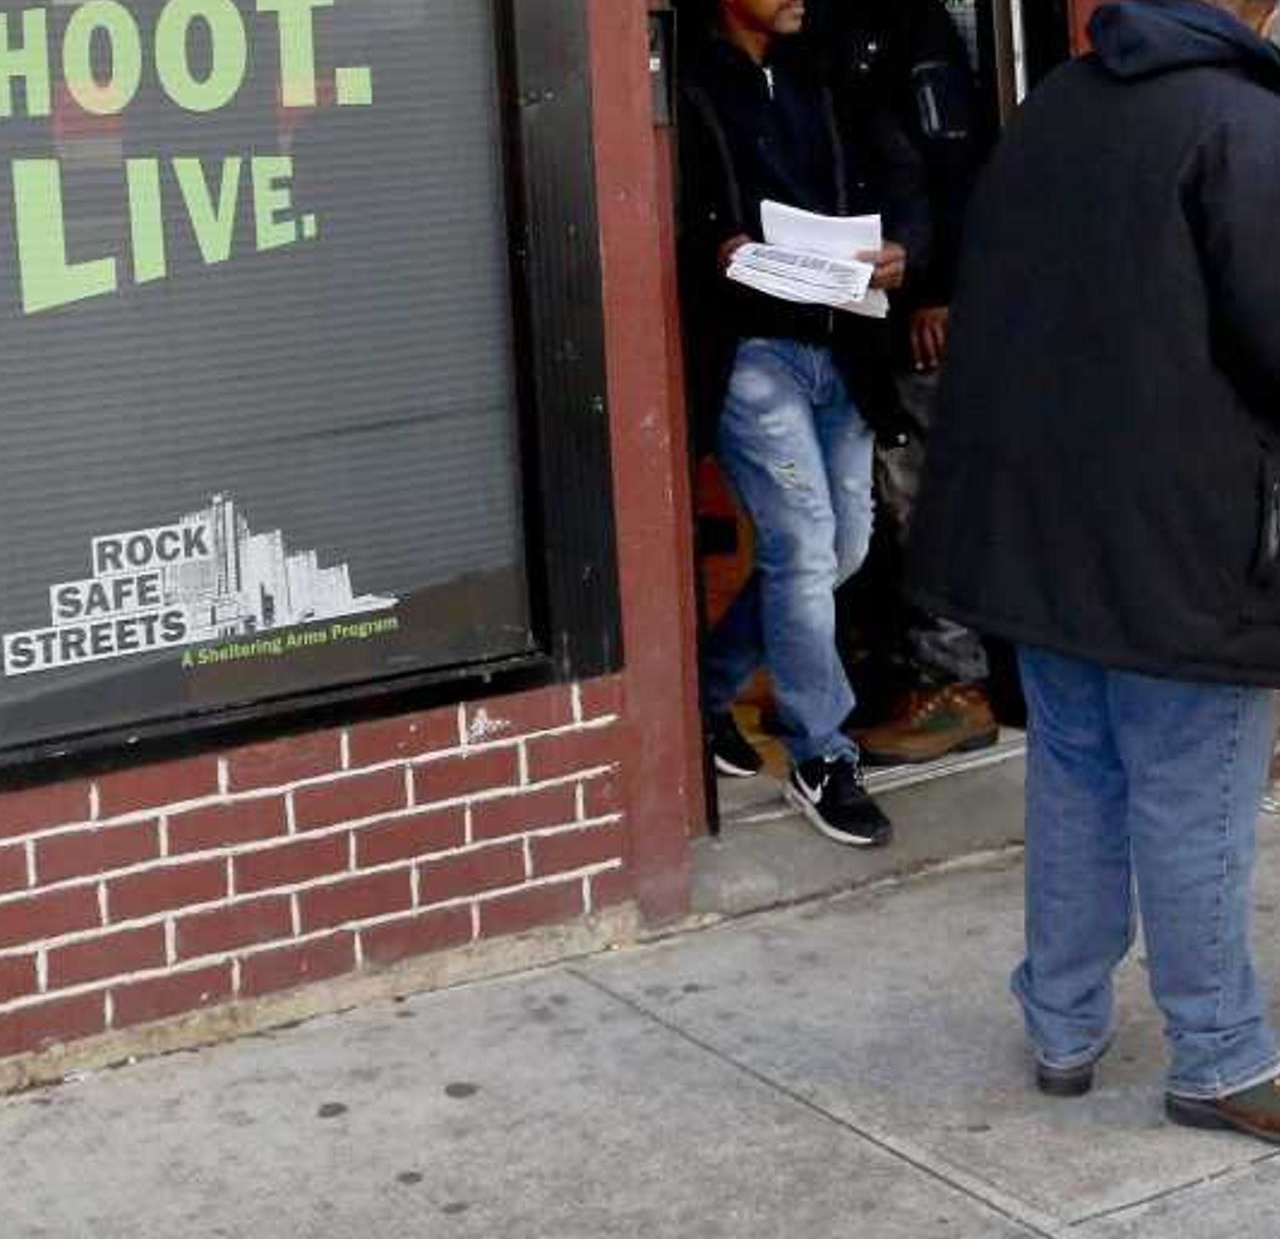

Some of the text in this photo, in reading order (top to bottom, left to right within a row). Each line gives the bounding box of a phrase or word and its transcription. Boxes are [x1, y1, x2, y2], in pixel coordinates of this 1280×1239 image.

[12, 156, 318, 315] LIVE.
[96, 525, 209, 573] ROCK
[56, 572, 161, 619] SAFE
[8, 609, 187, 671] STREETS
[181, 616, 400, 668] A Sheltering Arms Program
